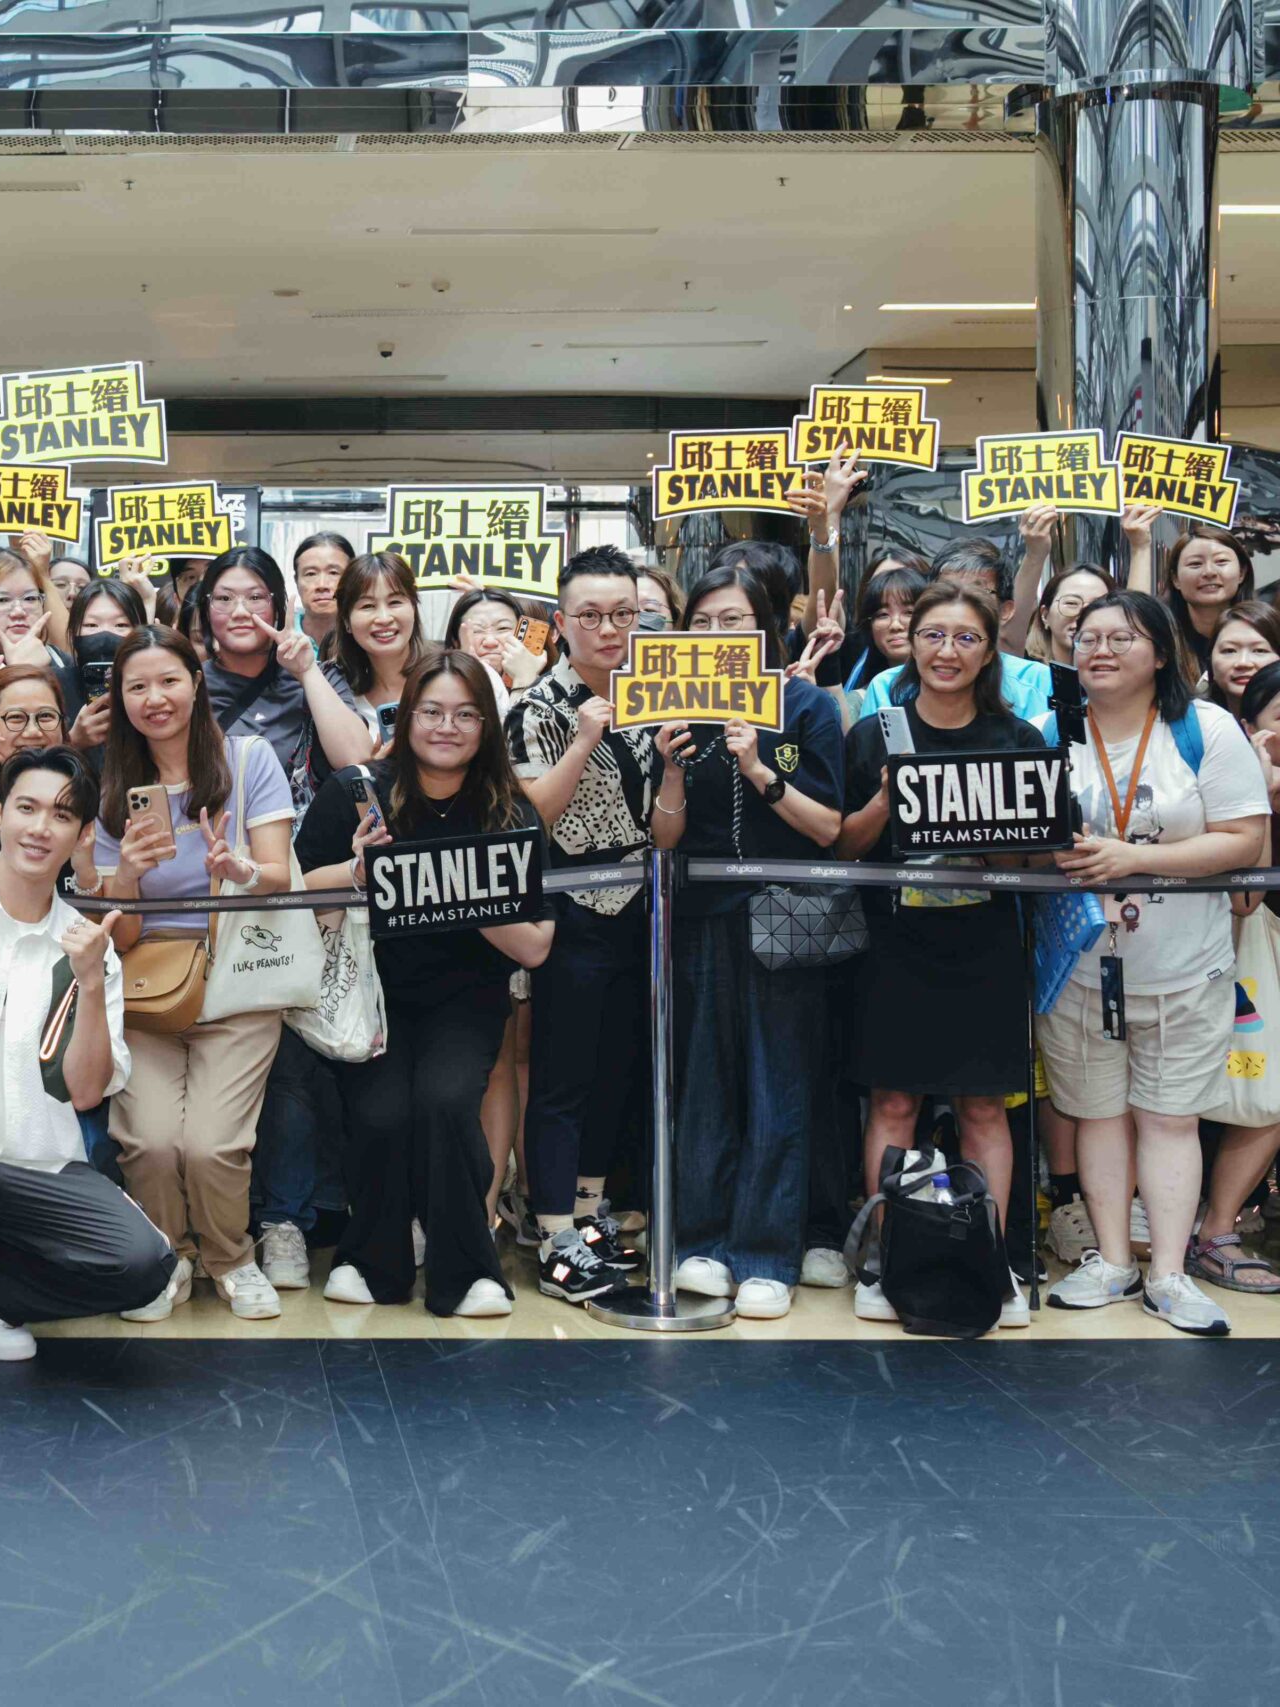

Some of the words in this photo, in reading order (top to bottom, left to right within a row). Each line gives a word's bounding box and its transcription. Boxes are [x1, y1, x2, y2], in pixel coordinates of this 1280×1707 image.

[14, 377, 130, 420] 邱士縉
[822, 396, 912, 426] 邱士縉
[0, 413, 150, 460] STANLEY
[806, 426, 926, 455] STANLEY
[681, 440, 779, 472] 邱士縉
[990, 442, 1090, 476] 邱士縉
[1123, 444, 1218, 483] 邱士縉
[667, 472, 797, 505] STANLEY
[978, 472, 1108, 508] STANLEY
[1122, 473, 1227, 512] TANLEY
[119, 493, 206, 524] 邱士縉
[400, 499, 530, 540] 邱士縉
[109, 520, 222, 554] STANLEY
[641, 644, 751, 680] 邱士縉
[625, 681, 770, 716] STANLEY
[896, 760, 1061, 825] STANLEY
[911, 826, 1050, 844] #TEAMSTANLEY
[373, 840, 533, 911] STANLEY
[726, 864, 763, 875] cityplaza
[810, 866, 848, 878] cityplaza
[896, 869, 934, 880] cityplaza
[387, 901, 522, 928] #TEAMSTANLEY
[232, 963, 237, 974] I
[238, 960, 255, 972] LIKE
[256, 954, 294, 970] PEANUTS!
